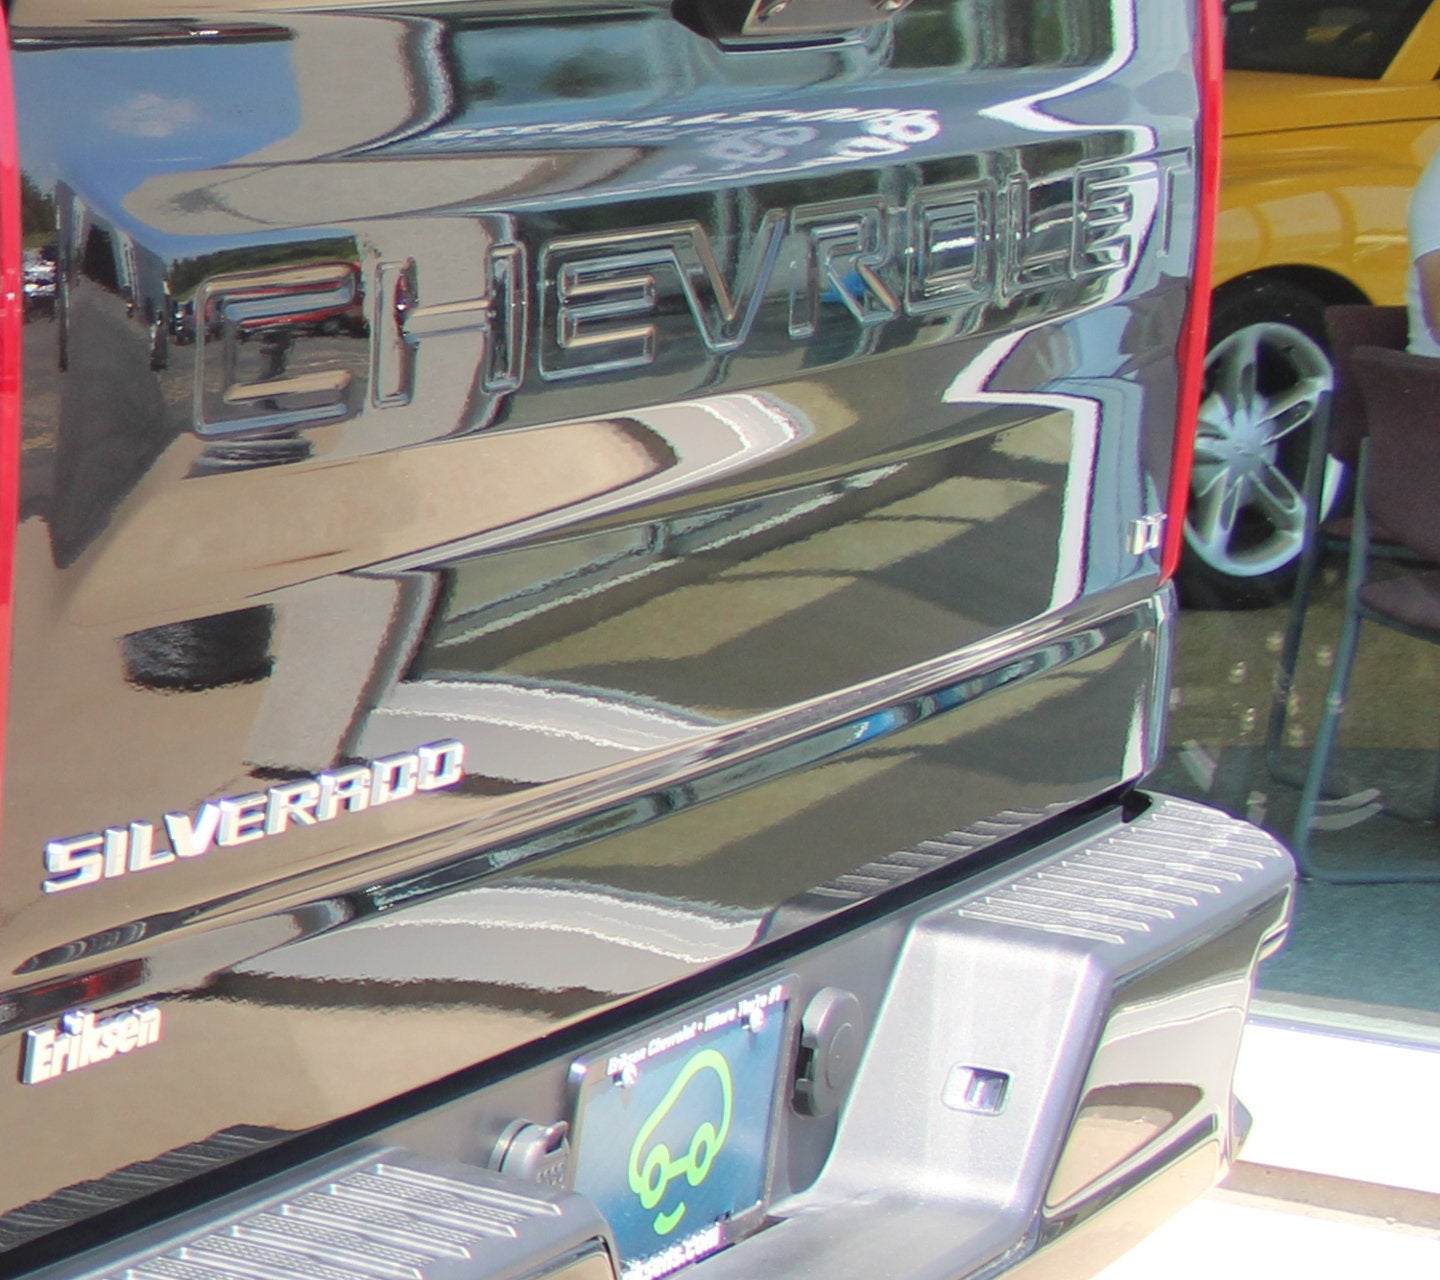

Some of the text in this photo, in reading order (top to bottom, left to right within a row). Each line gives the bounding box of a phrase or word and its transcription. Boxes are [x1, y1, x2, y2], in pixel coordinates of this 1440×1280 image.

[193, 146, 1195, 440] CHEVROLET
[41, 738, 466, 894] SILVERADO
[20, 1003, 164, 1085] Eriksen
